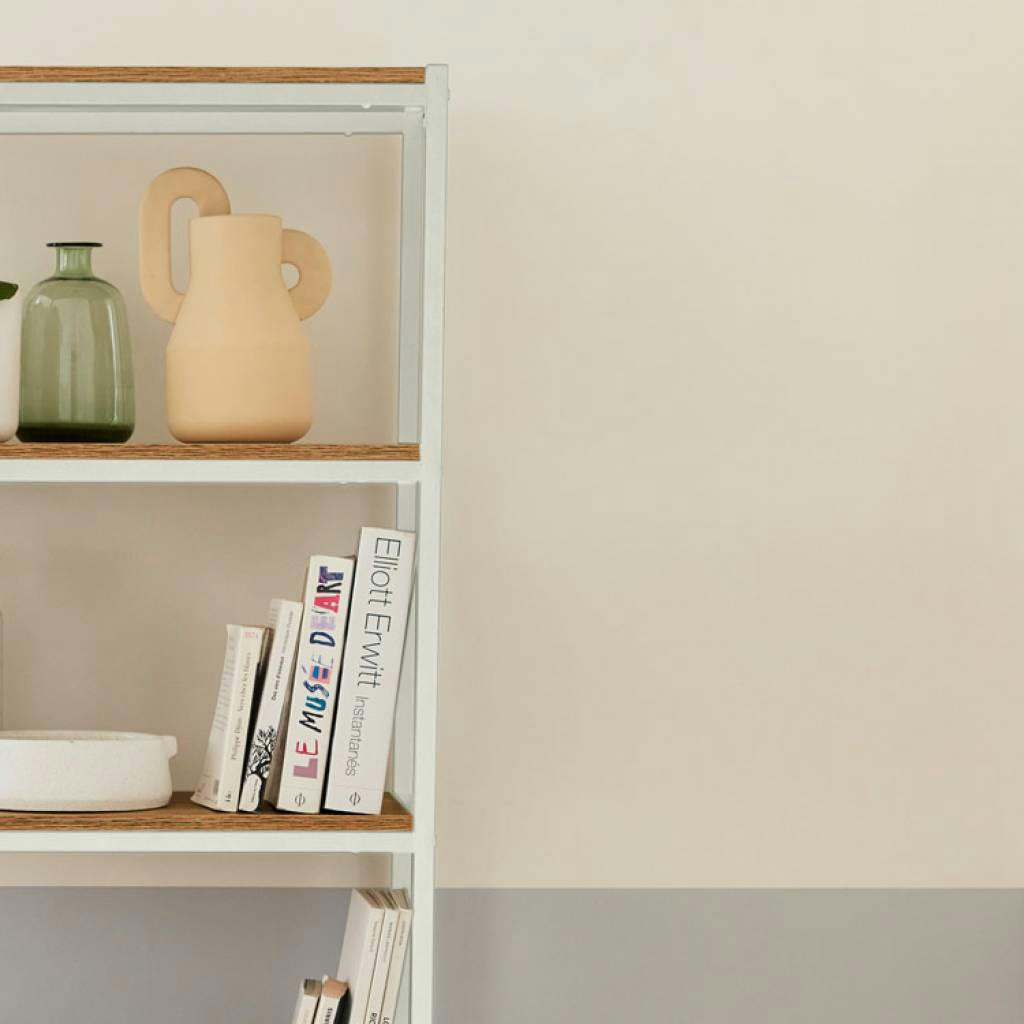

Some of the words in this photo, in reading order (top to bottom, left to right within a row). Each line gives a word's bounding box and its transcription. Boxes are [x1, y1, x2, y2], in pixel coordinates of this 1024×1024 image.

[368, 536, 401, 607] Elliott
[357, 612, 392, 690] Erwitt
[292, 738, 319, 779] LE
[344, 695, 369, 777] Instantanés
